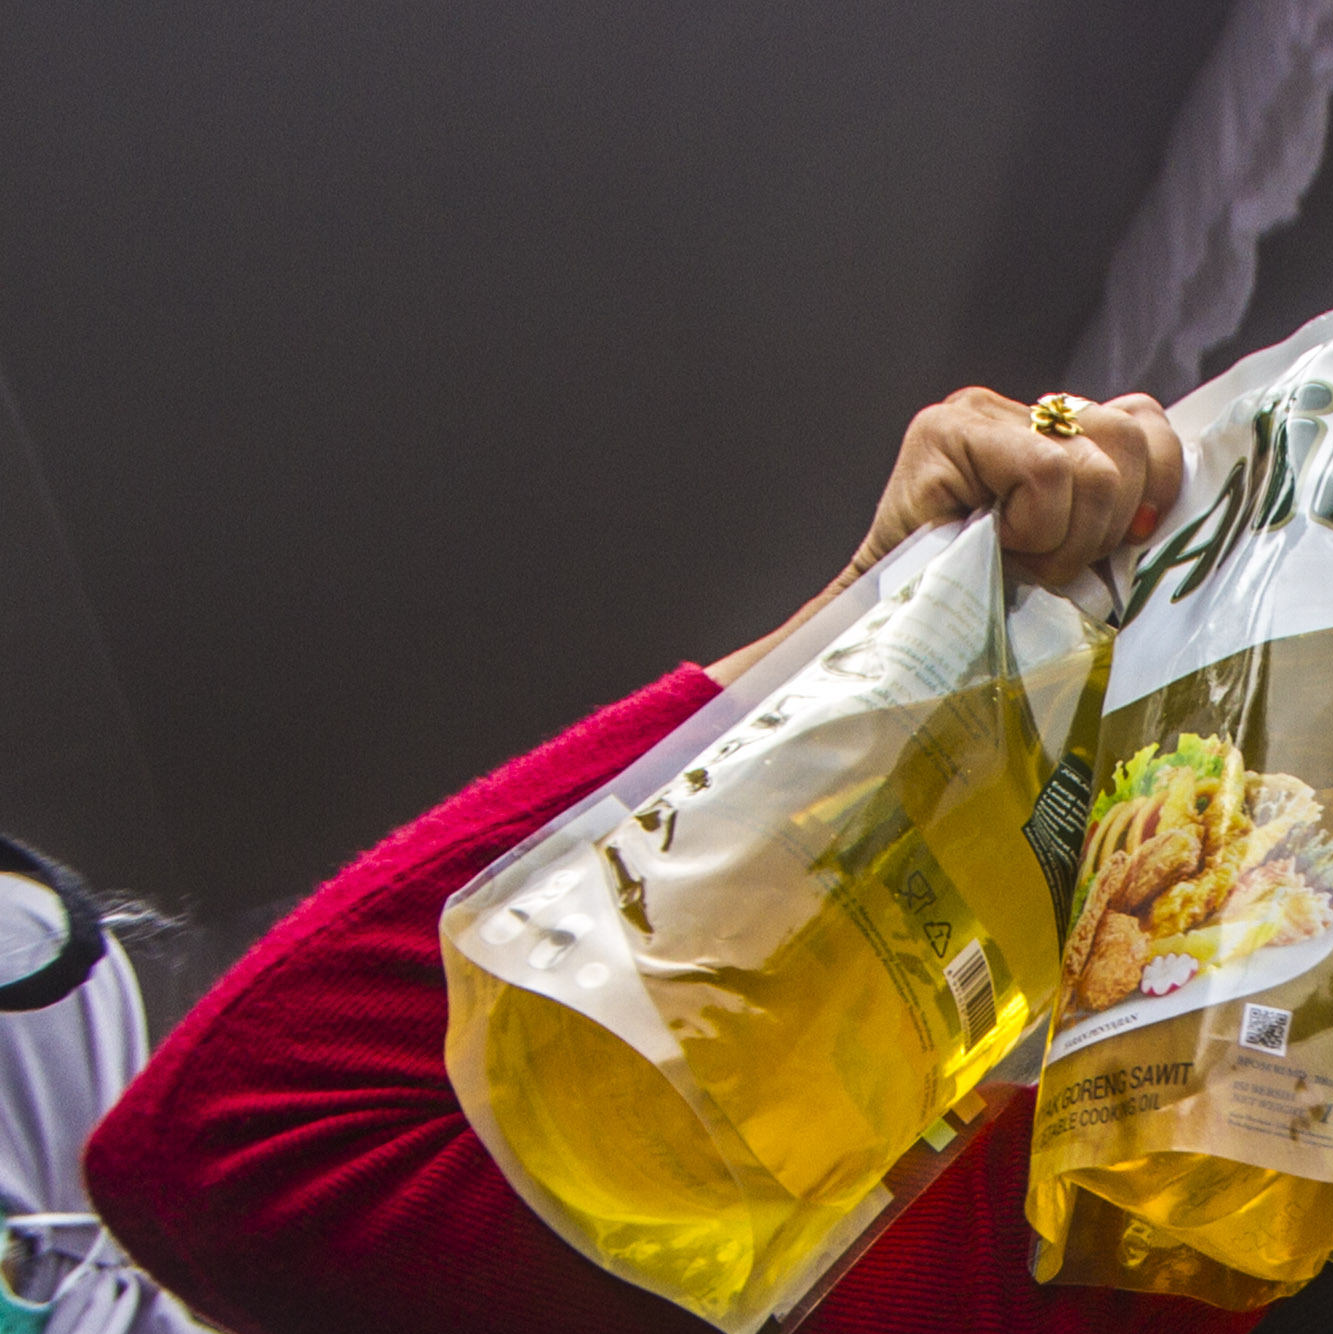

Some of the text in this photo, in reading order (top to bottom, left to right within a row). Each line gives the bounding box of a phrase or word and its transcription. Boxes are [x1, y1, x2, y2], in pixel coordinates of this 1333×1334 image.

[1061, 1069, 1127, 1110] GORENG
[1129, 1061, 1194, 1090] SAWIT
[1080, 1096, 1137, 1126] COOKING
[1139, 1092, 1161, 1113] OIL
